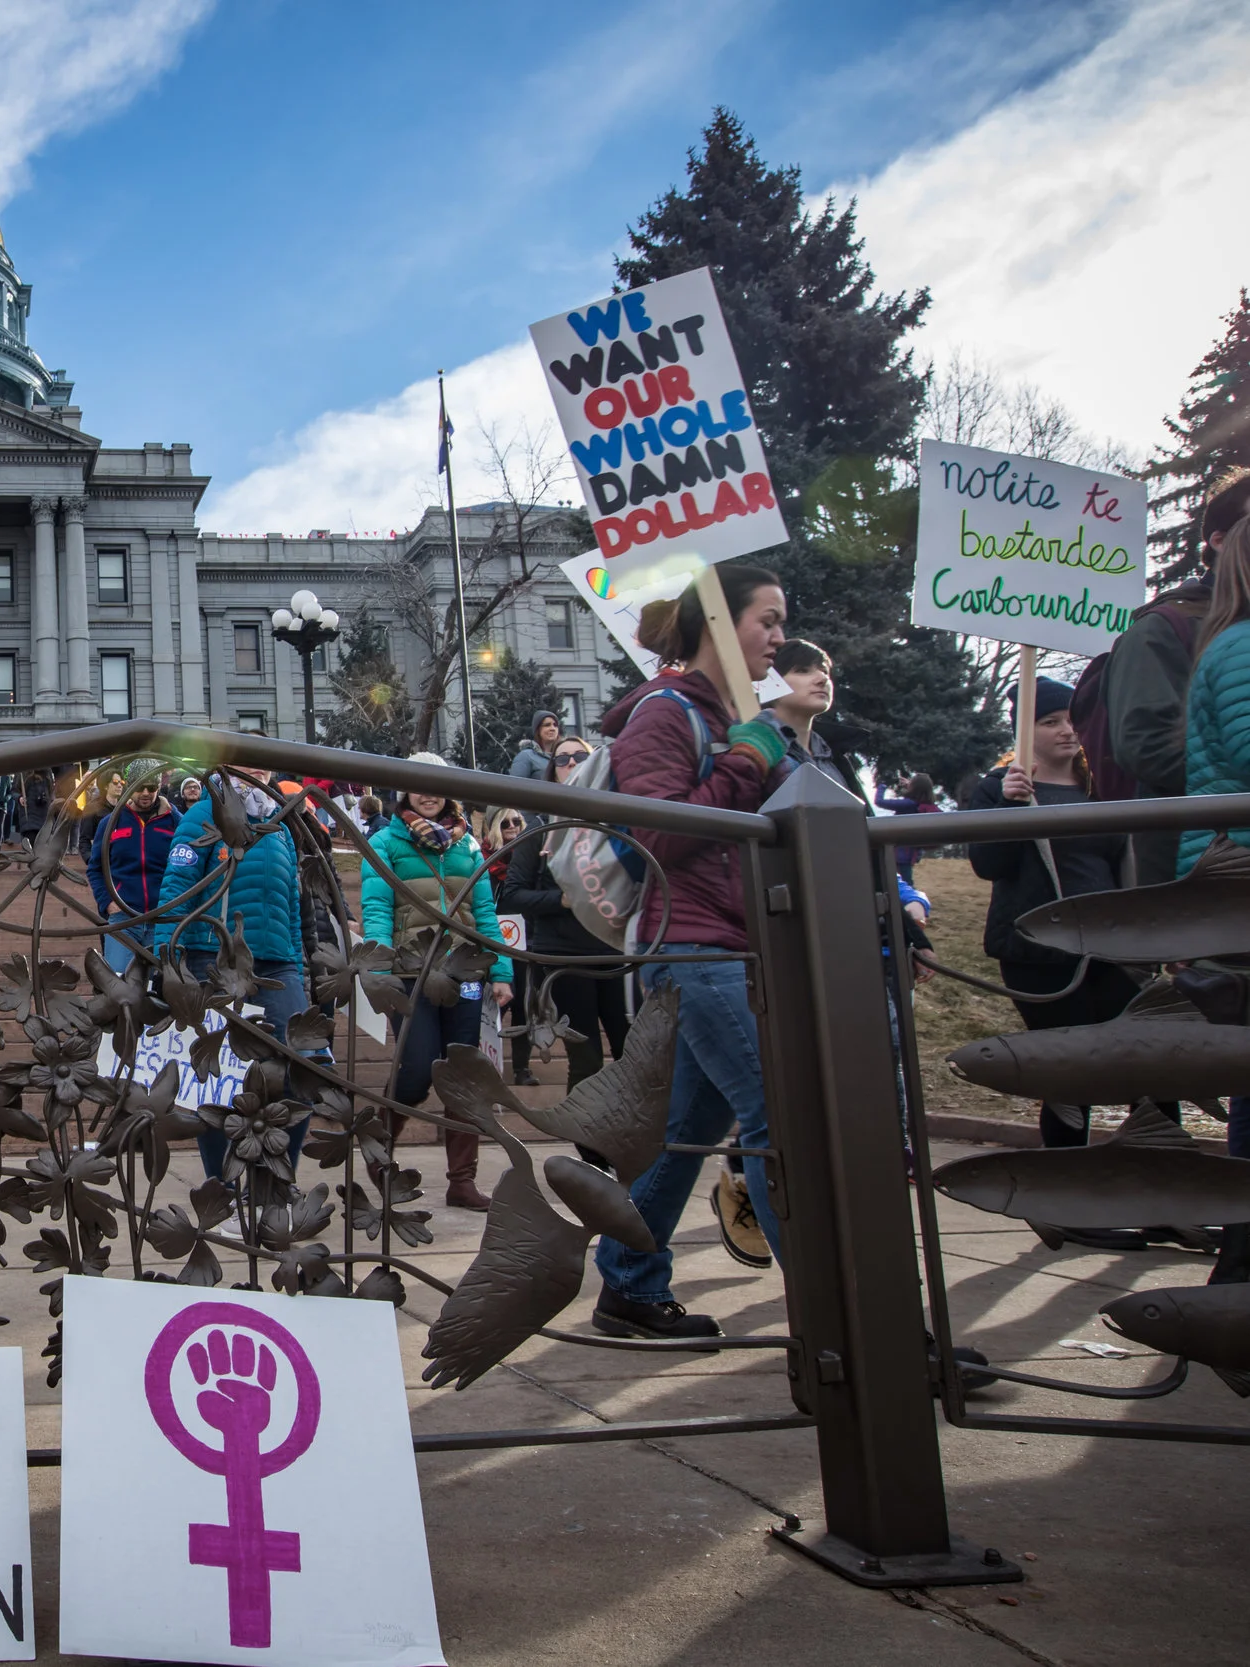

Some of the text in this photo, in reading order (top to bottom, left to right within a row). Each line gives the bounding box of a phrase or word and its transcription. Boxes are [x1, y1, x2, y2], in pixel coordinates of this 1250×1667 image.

[550, 314, 705, 395] WANT
[567, 292, 652, 347] WE
[570, 389, 752, 476] WHOLE
[584, 365, 695, 430] OUR
[589, 434, 746, 516] DAMN
[940, 460, 1122, 522] nolite te
[593, 472, 775, 559] DOLLAR
[960, 509, 1137, 575] bastardes
